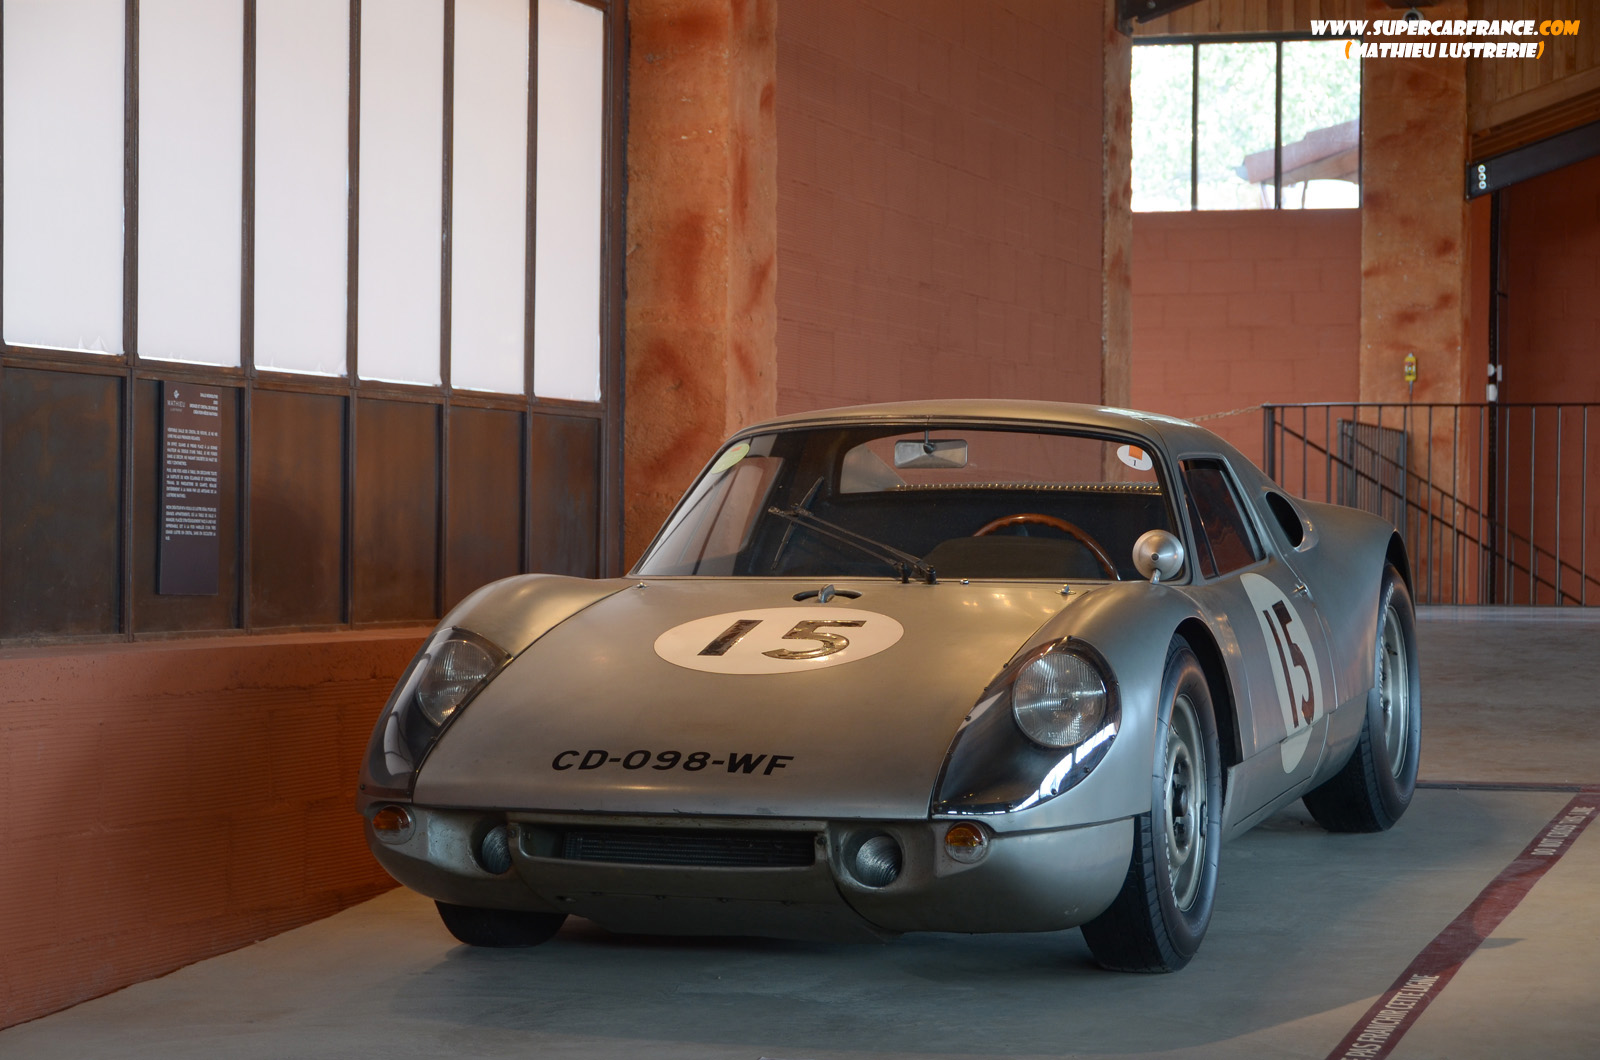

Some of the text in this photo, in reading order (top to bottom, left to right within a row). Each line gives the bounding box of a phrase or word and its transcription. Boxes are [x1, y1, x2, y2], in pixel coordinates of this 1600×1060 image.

[697, 620, 867, 660] 15
[1263, 600, 1315, 729] 15
[552, 750, 795, 776] CD-098-WF
[1400, 973, 1440, 993] LIGNE
[1385, 991, 1425, 1009] CETTE
[1356, 1009, 1409, 1043] FRANCHIR
[1345, 1043, 1382, 1058] PAS
